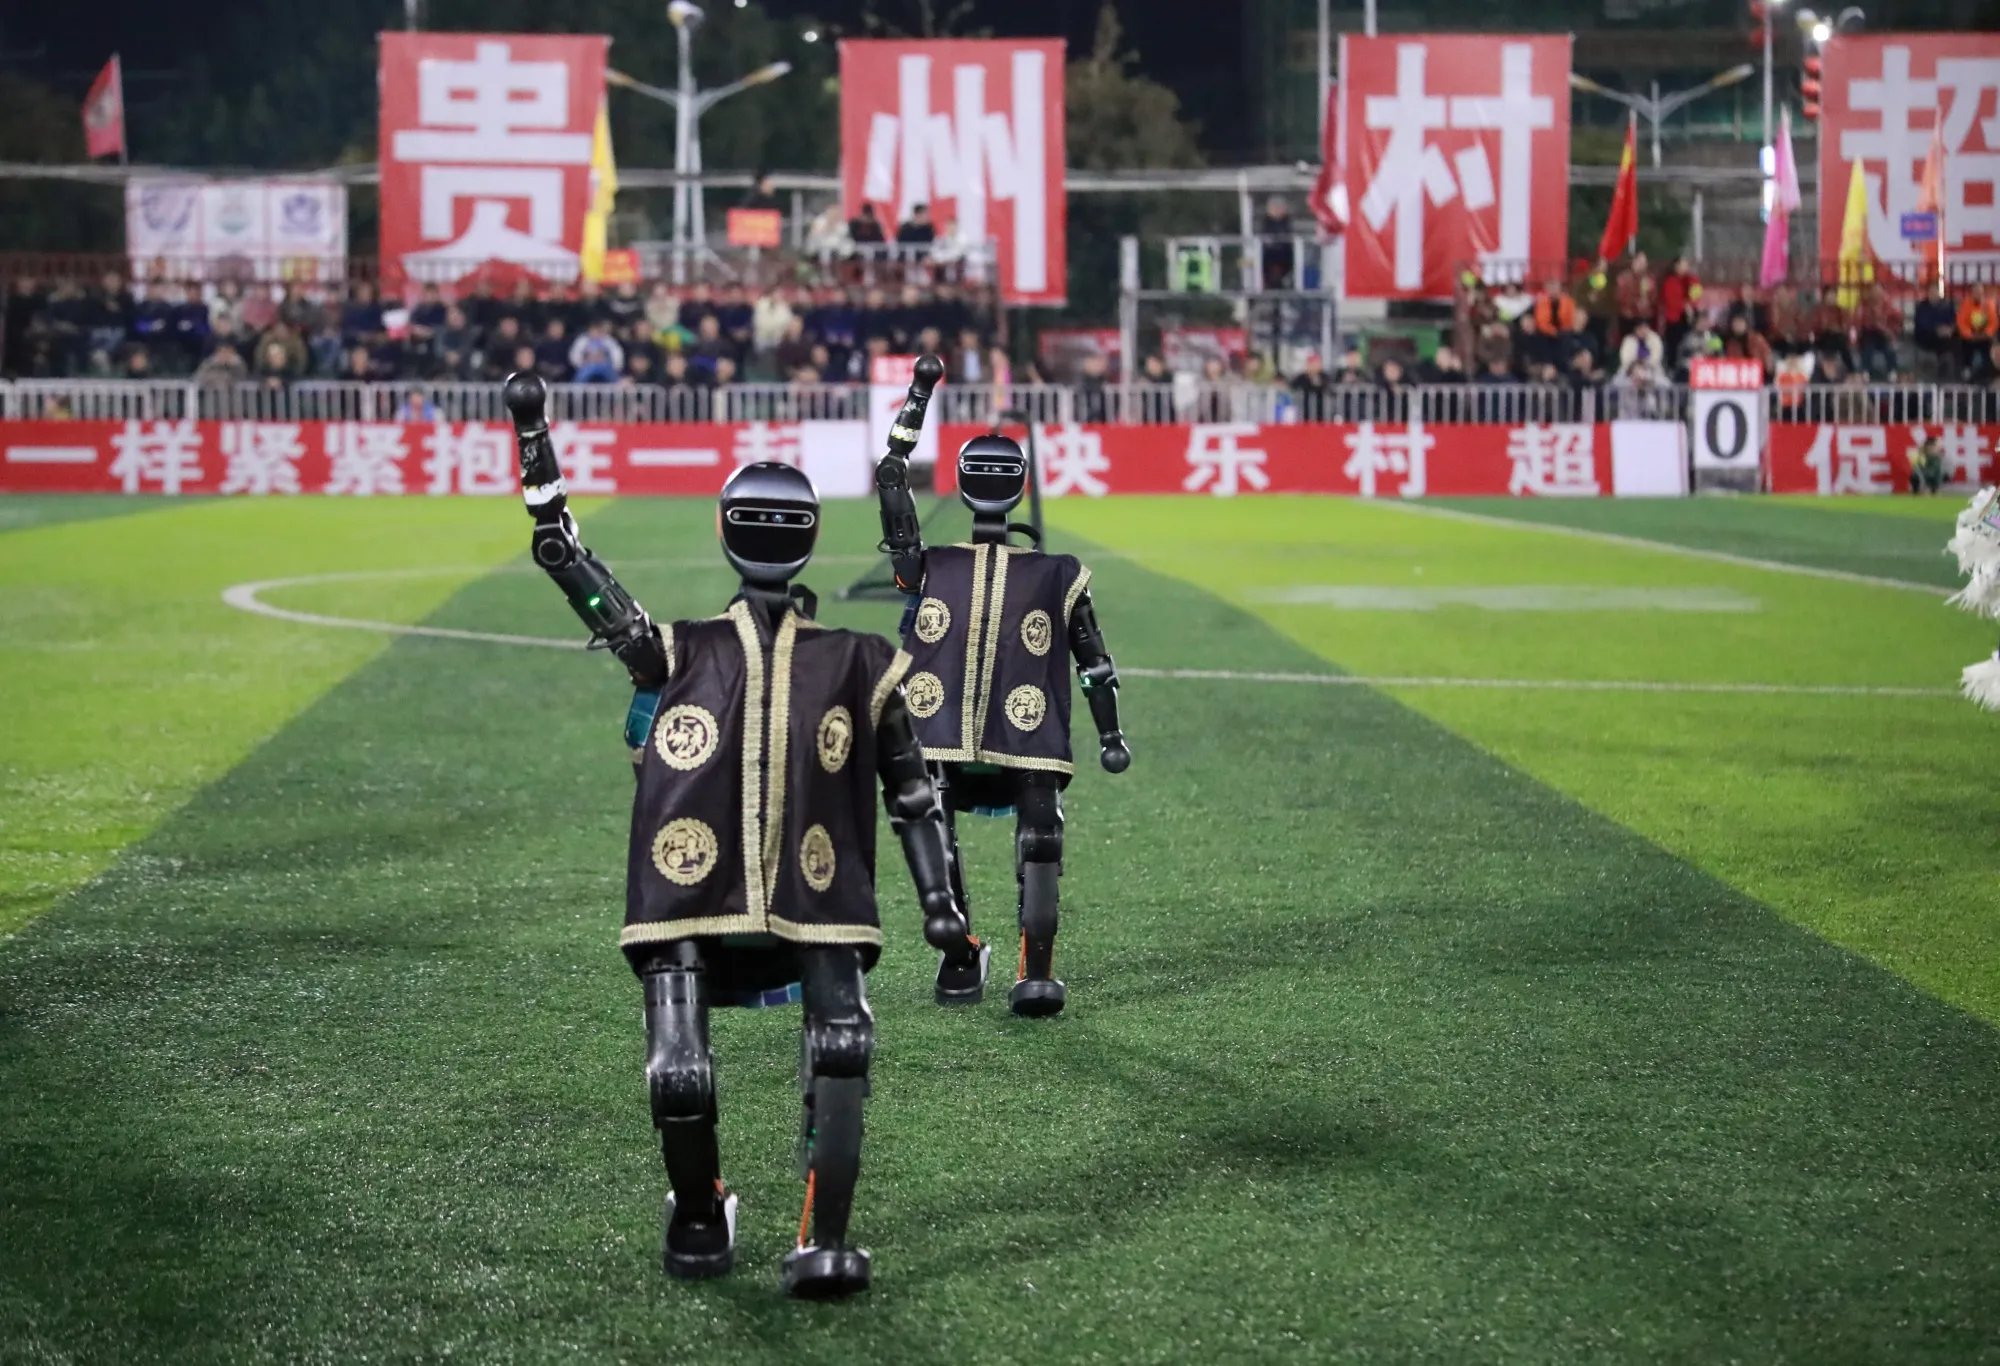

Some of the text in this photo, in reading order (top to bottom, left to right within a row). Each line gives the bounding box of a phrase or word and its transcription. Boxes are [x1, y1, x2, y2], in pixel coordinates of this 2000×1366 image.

[393, 41, 591, 285] 贵
[865, 50, 1046, 291] 州
[1361, 43, 1553, 289] 村
[1841, 46, 2000, 284] 超
[1705, 400, 1748, 460] 0
